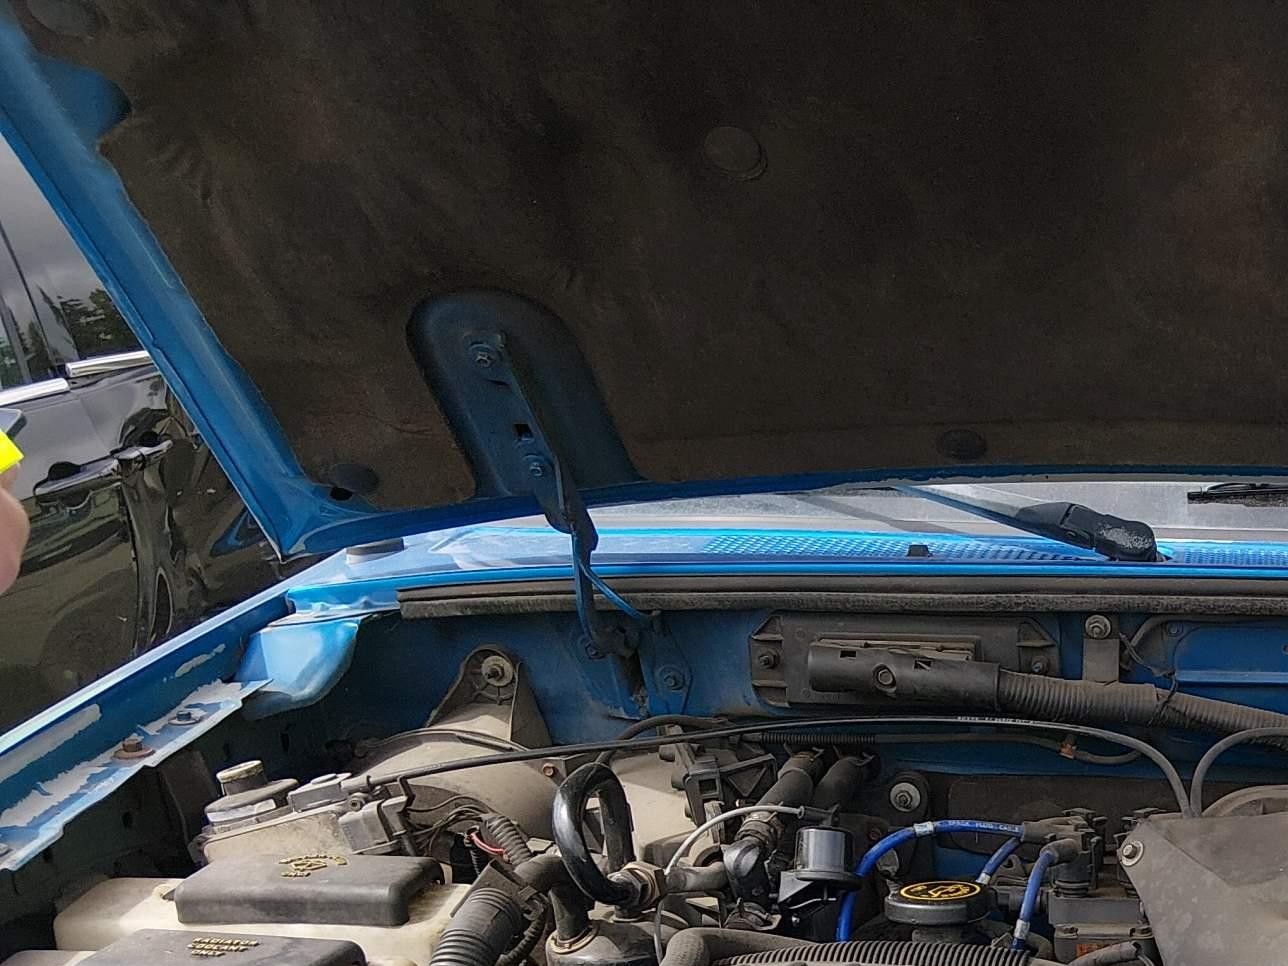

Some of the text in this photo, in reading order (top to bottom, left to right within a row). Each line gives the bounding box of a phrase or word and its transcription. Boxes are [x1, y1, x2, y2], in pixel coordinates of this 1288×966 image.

[192, 937, 260, 947] RADIATOR
[187, 943, 249, 953] COOLANT
[190, 949, 226, 958] ONLY
